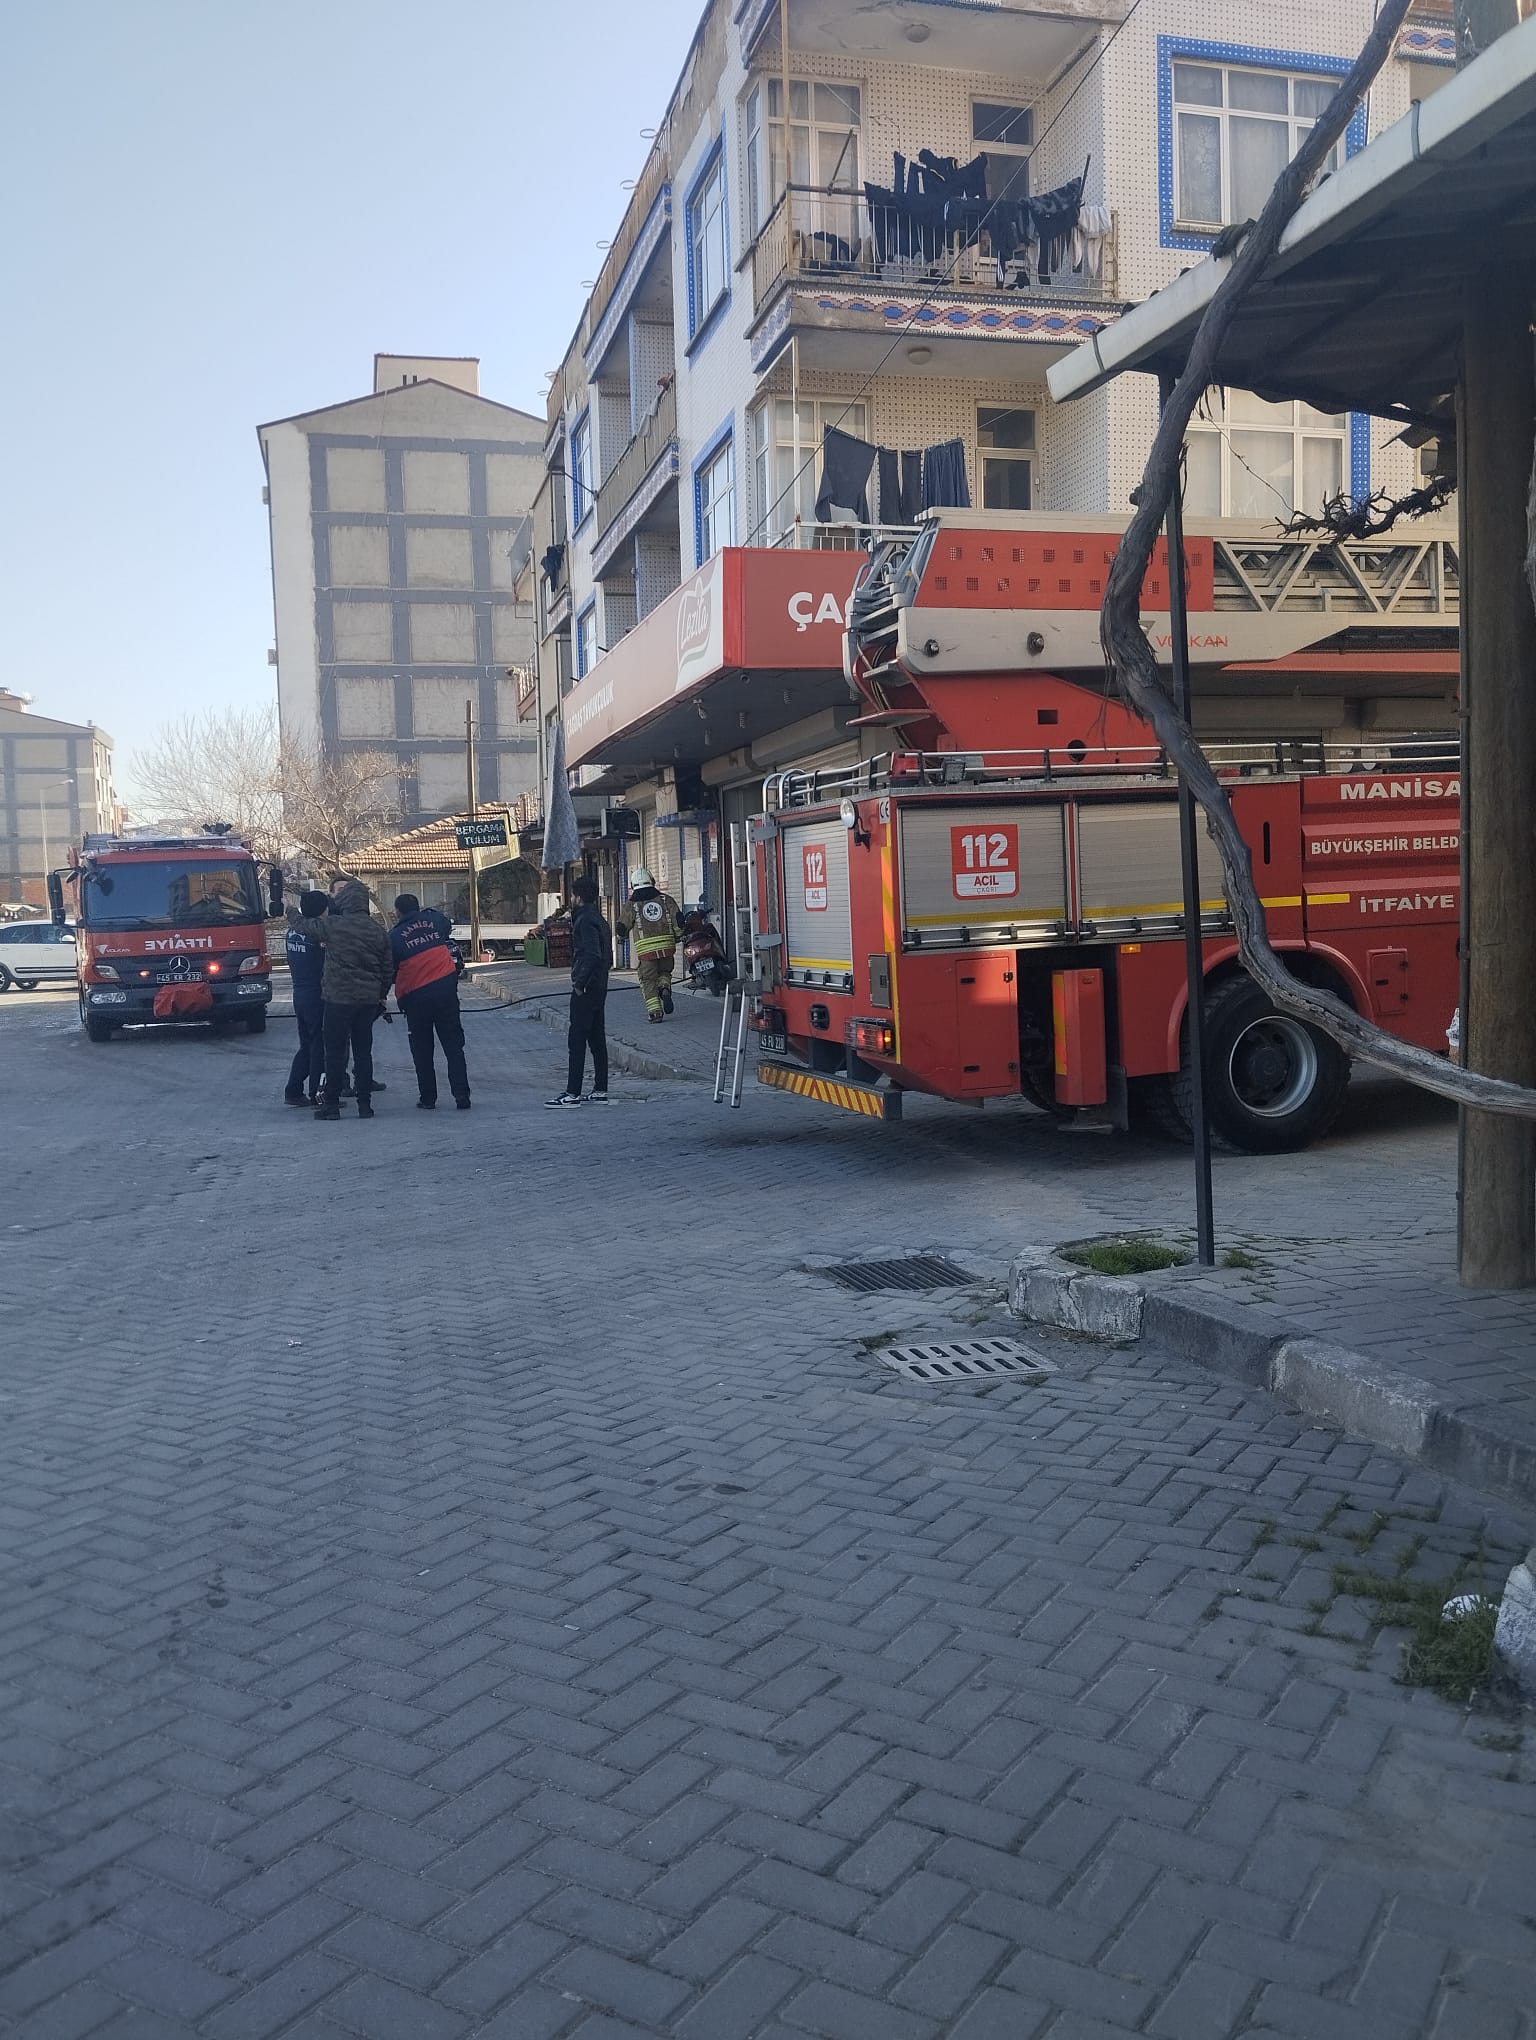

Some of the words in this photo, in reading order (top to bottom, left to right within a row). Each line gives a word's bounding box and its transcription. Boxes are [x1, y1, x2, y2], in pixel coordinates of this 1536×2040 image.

[679, 594, 709, 649] Lezita
[1340, 778, 1461, 800] MANİSA
[464, 834, 500, 845] TULUM
[1311, 836, 1409, 855] BÜYÜKŞEHİR
[961, 833, 1008, 867] 112
[806, 853, 823, 883] 112
[974, 875, 999, 886] ACİL
[1360, 894, 1455, 913] İTFAİYE
[401, 920, 434, 938] MANİSA
[405, 932, 440, 948] İTFAİYE
